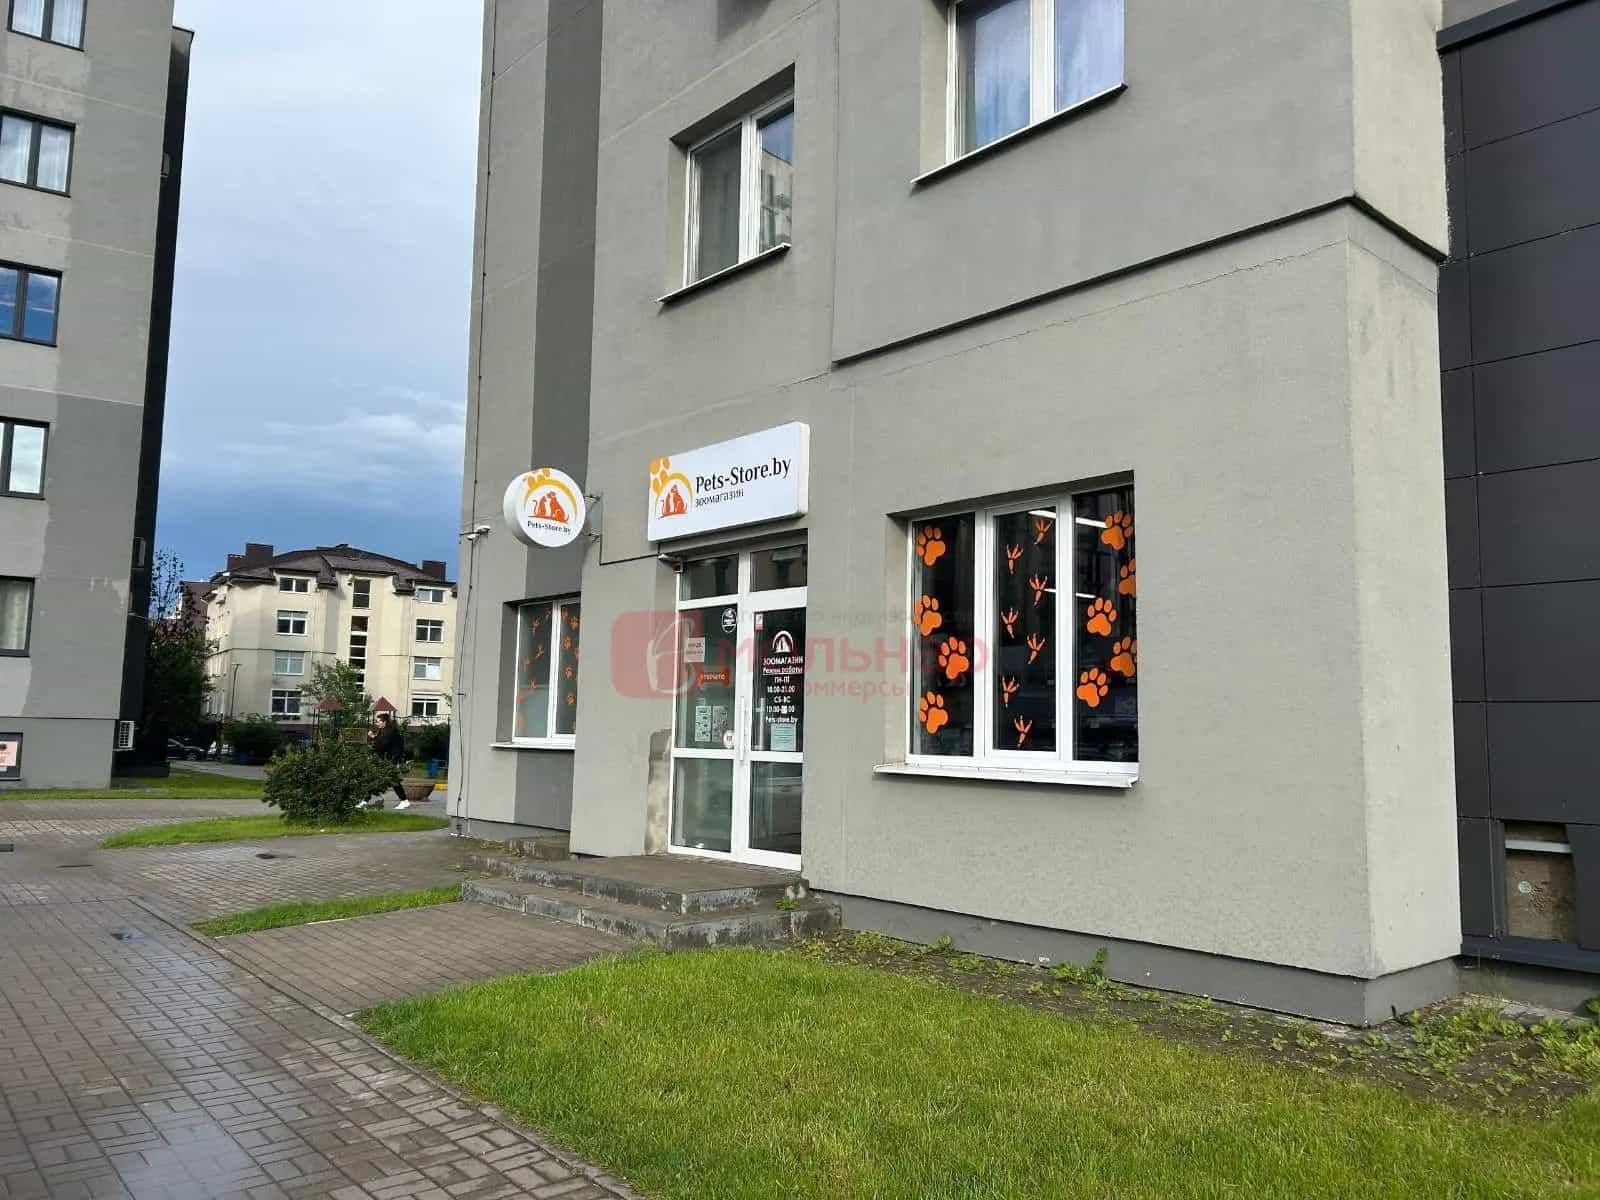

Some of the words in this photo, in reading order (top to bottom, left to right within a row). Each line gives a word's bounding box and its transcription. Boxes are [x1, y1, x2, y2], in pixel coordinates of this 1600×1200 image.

[696, 457, 791, 493] Pets-Store.by
[696, 488, 744, 507] зоомагазин
[527, 520, 572, 535] Pets-Store.by
[762, 656, 804, 666] ЗООМАГАЗИН
